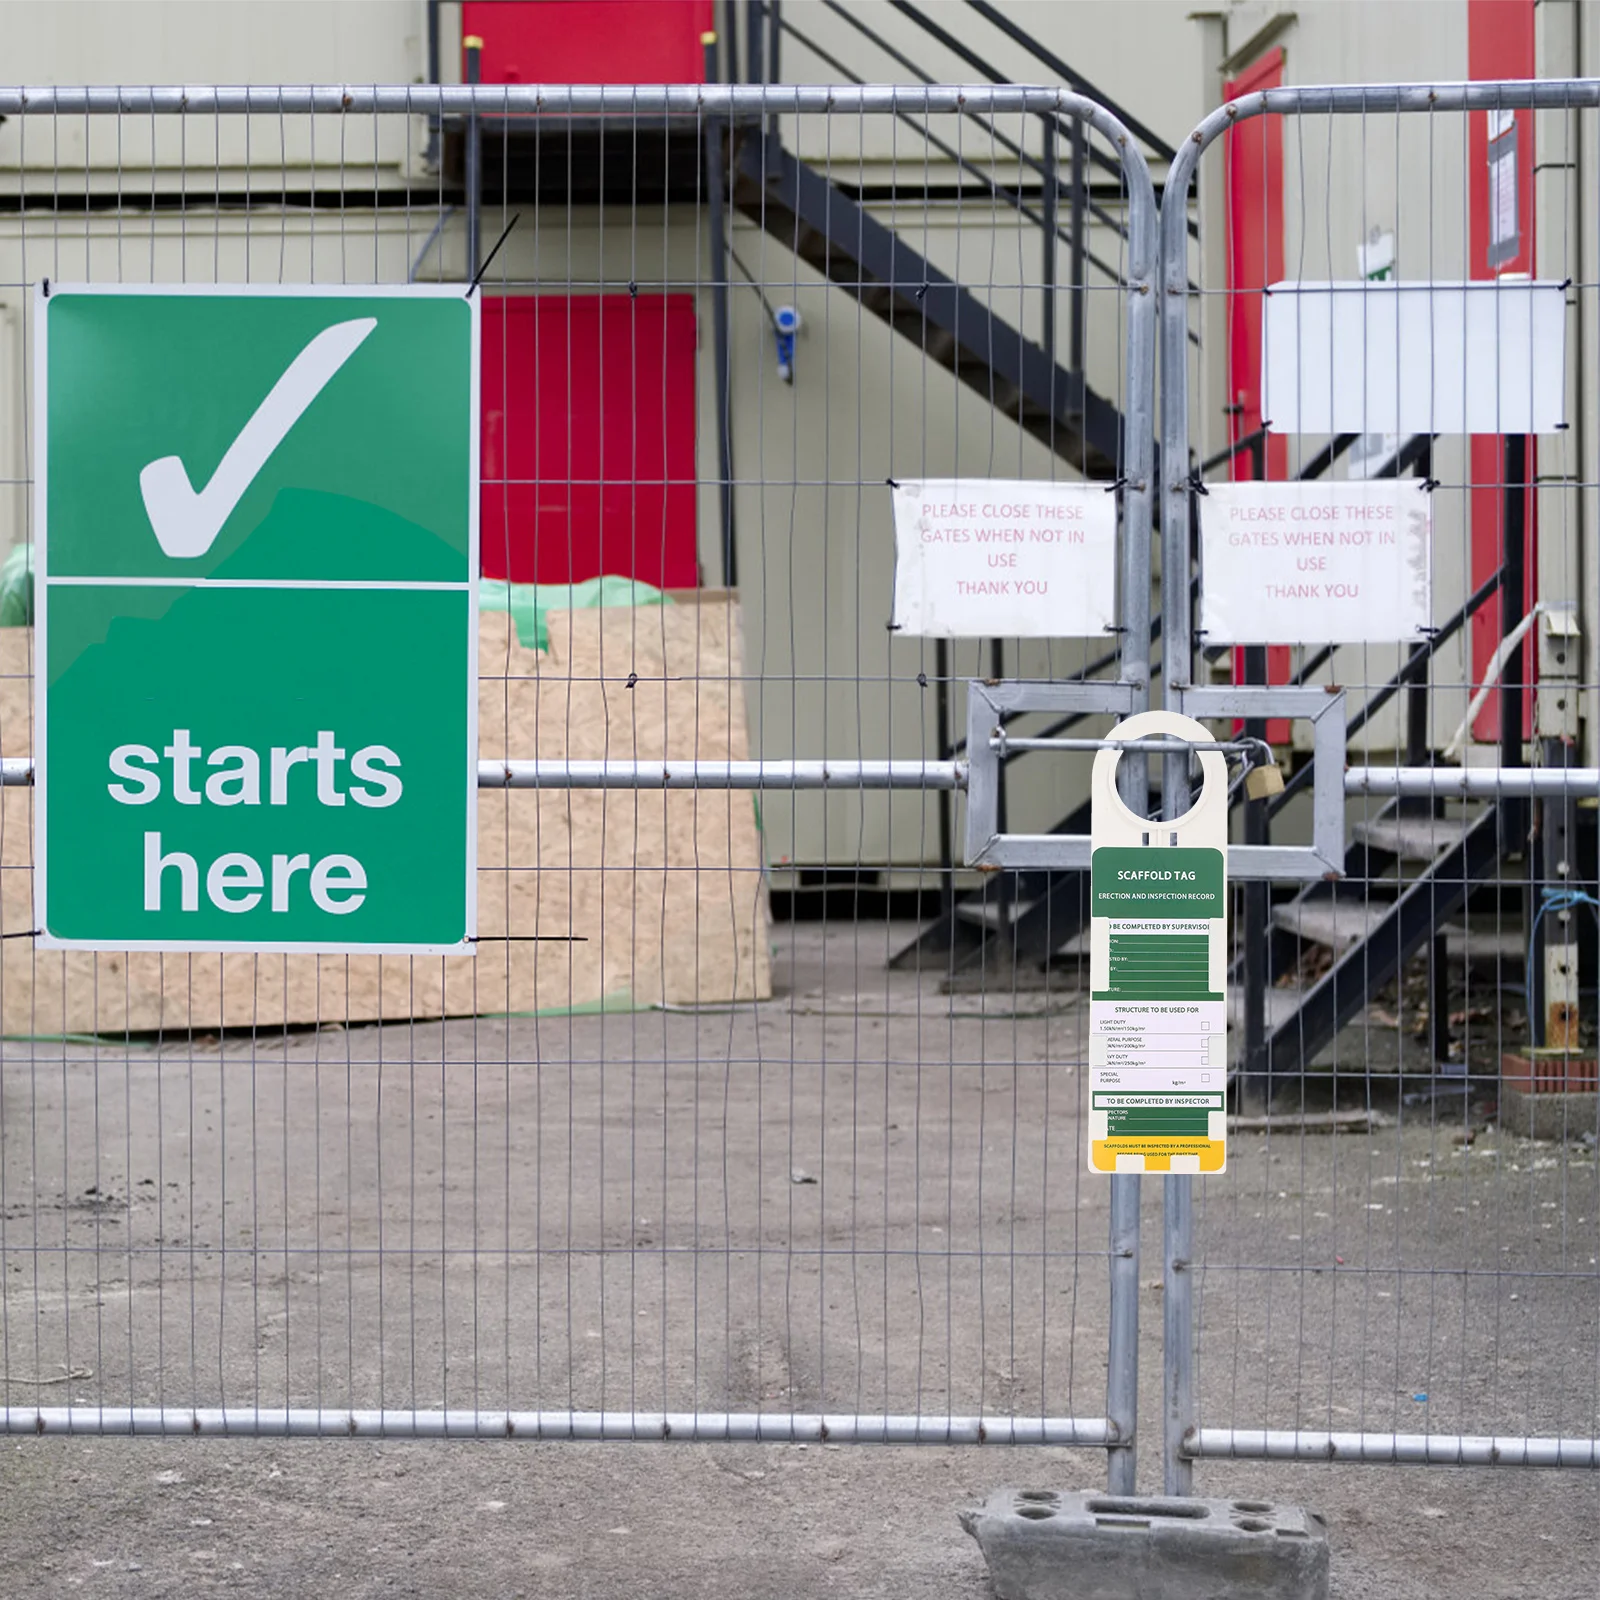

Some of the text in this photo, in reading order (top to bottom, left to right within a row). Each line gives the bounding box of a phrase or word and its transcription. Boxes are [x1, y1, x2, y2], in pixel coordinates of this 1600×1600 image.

[922, 503, 1083, 519] PLEASE CLOSE THESE
[1230, 505, 1393, 521] PLEASE CLOSE THESE
[921, 529, 1085, 544] GATES WHEN NOT IN
[1228, 531, 1395, 546] GATES WHEN NOT IN
[988, 553, 1017, 568] USE
[1296, 556, 1326, 571] USE
[956, 580, 1048, 595] THANK YOU
[1265, 583, 1360, 598] THANK YOU
[107, 729, 404, 808] starts
[144, 831, 368, 915] here
[1117, 870, 1196, 881] SCAFFOLD TAG
[1098, 892, 1131, 900] ERECTION
[1131, 892, 1147, 900] AND
[1147, 892, 1187, 900] INSPECTION
[1114, 1006, 1200, 1014] STRUCTURE TO BE USED FOR
